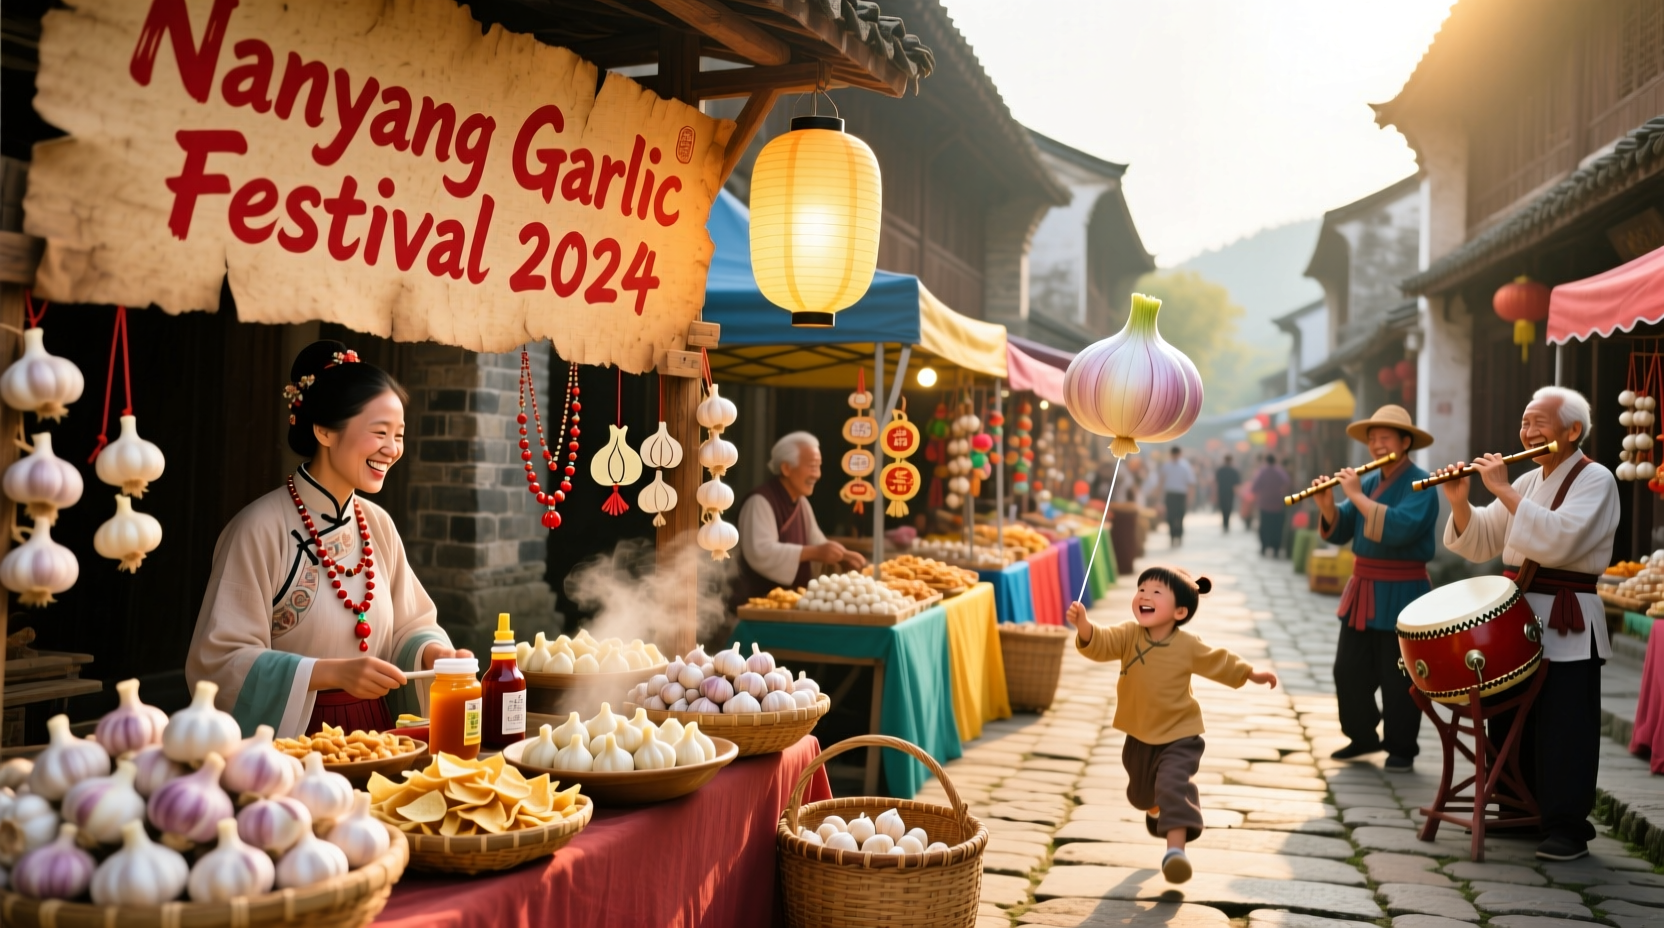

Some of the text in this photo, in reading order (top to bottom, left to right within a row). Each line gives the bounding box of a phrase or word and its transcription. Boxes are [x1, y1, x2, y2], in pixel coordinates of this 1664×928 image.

[129, 0, 684, 228] Nanyang Garlic
[165, 129, 661, 317] Festival 2024
